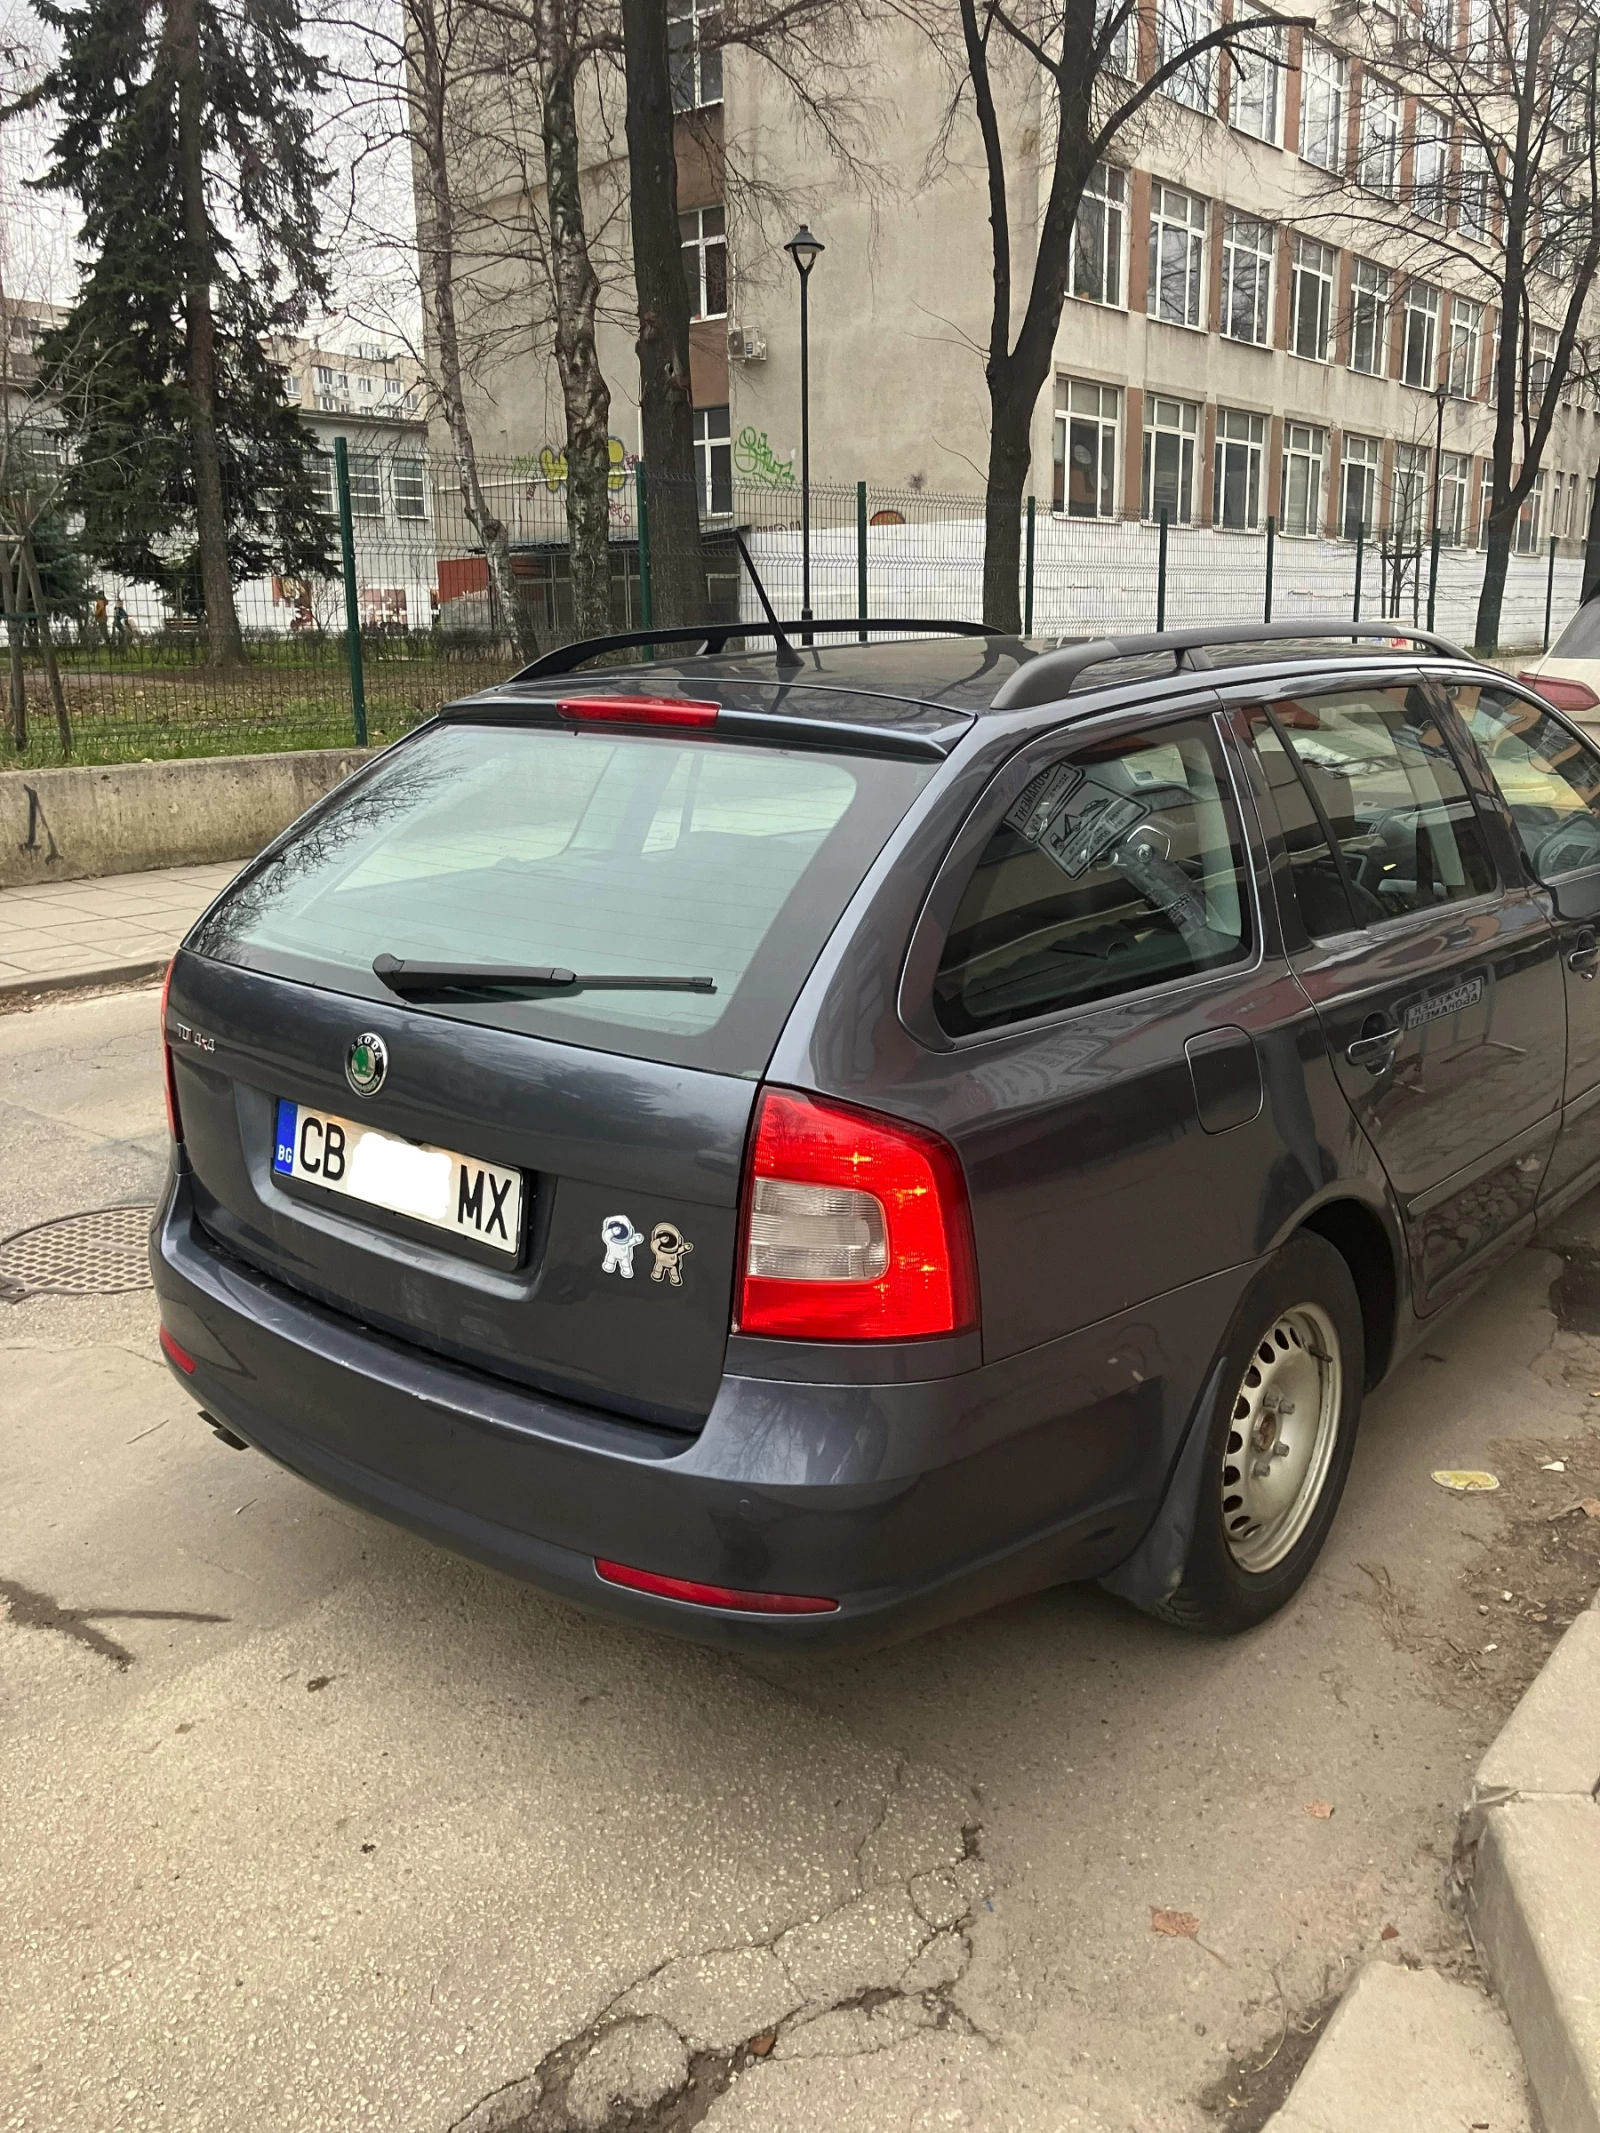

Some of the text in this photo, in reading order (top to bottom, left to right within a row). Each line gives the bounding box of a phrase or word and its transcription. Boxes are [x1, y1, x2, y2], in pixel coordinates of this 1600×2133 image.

[278, 1144, 293, 1165] BG
[301, 1116, 512, 1240] CB MX
